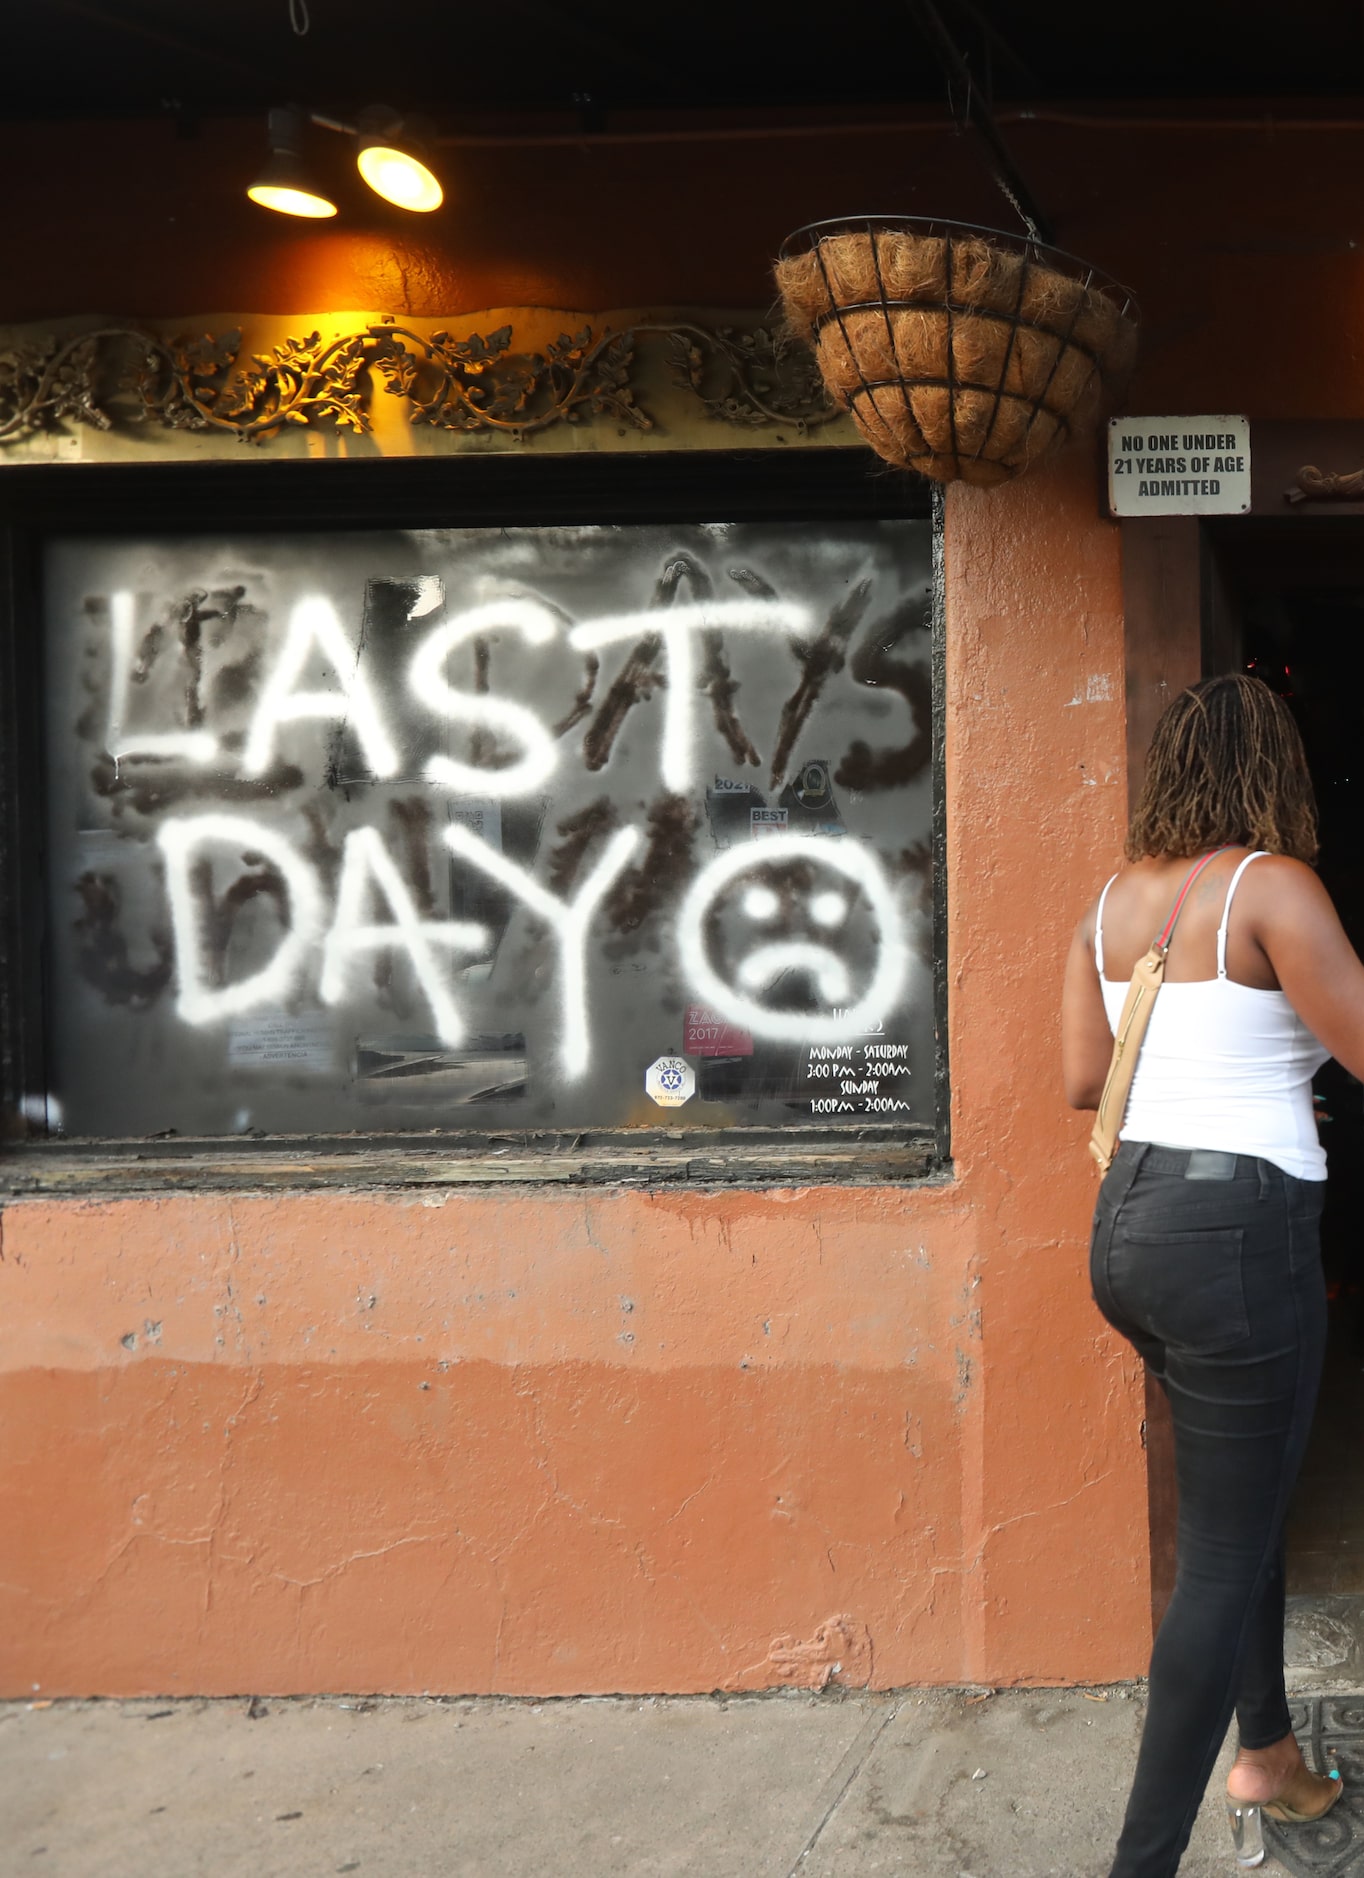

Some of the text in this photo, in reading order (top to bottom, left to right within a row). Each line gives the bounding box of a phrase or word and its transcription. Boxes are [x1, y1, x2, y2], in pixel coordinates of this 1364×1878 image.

[1122, 434, 1236, 451] NO ONE UNDER
[1114, 456, 1244, 474] 21 YEARS OF AGE
[1138, 480, 1220, 496] ADMITTED
[109, 590, 816, 799] LAST
[752, 810, 787, 821] BEST
[158, 812, 642, 1082] DAY
[688, 1027, 719, 1041] 2017
[809, 1046, 853, 1060] MONDAY
[863, 1044, 909, 1059] SATURDAY
[656, 1059, 687, 1074] VANCO
[807, 1064, 829, 1079] 3:00
[865, 1062, 911, 1077] 2:00AM
[666, 1075, 676, 1085] V
[840, 1080, 879, 1095] SUNDAY
[810, 1098, 854, 1113] 1:00PM
[864, 1097, 911, 1112] 2:00AM
